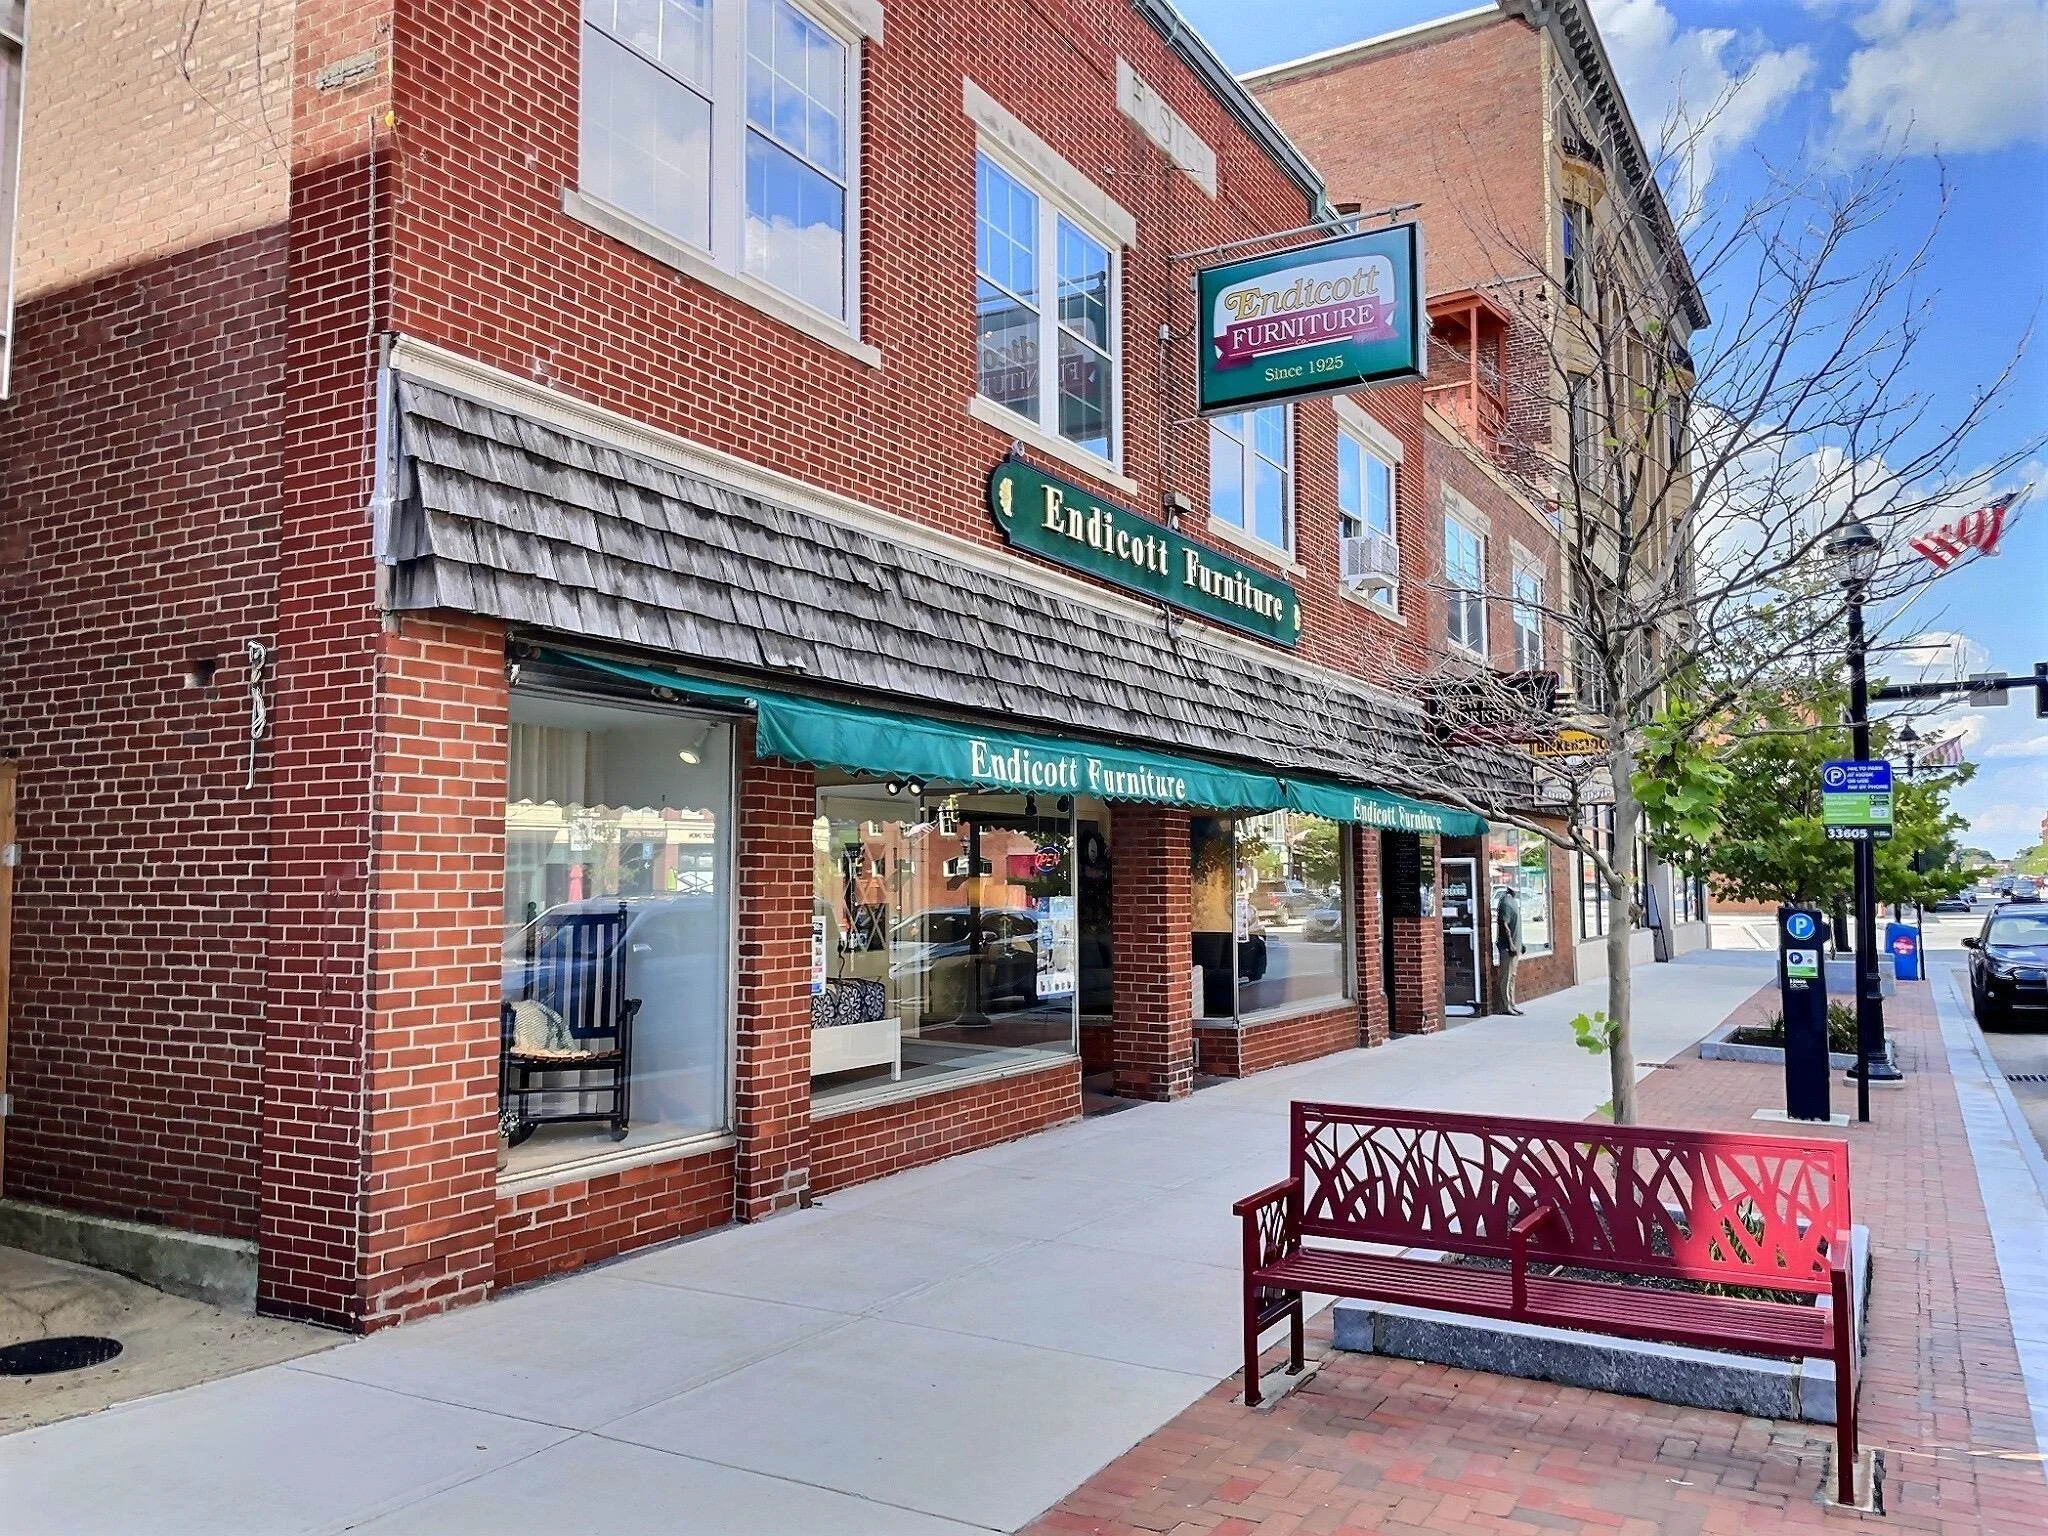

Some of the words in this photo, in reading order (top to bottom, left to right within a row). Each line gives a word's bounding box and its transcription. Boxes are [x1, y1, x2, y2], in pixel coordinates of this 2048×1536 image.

[1224, 264, 1380, 321] Endicott
[1232, 304, 1375, 350] FURNITURE
[1265, 366, 1303, 382] Since
[1309, 355, 1344, 374] 1925
[1041, 484, 1169, 577] Endicott
[1182, 547, 1284, 622] Furniture
[969, 738, 1079, 788] Endicott
[1087, 757, 1187, 800] Furniture
[1353, 796, 1397, 826] Endicott
[1398, 805, 1442, 831] Furniture
[1828, 828, 1868, 839] 33605
